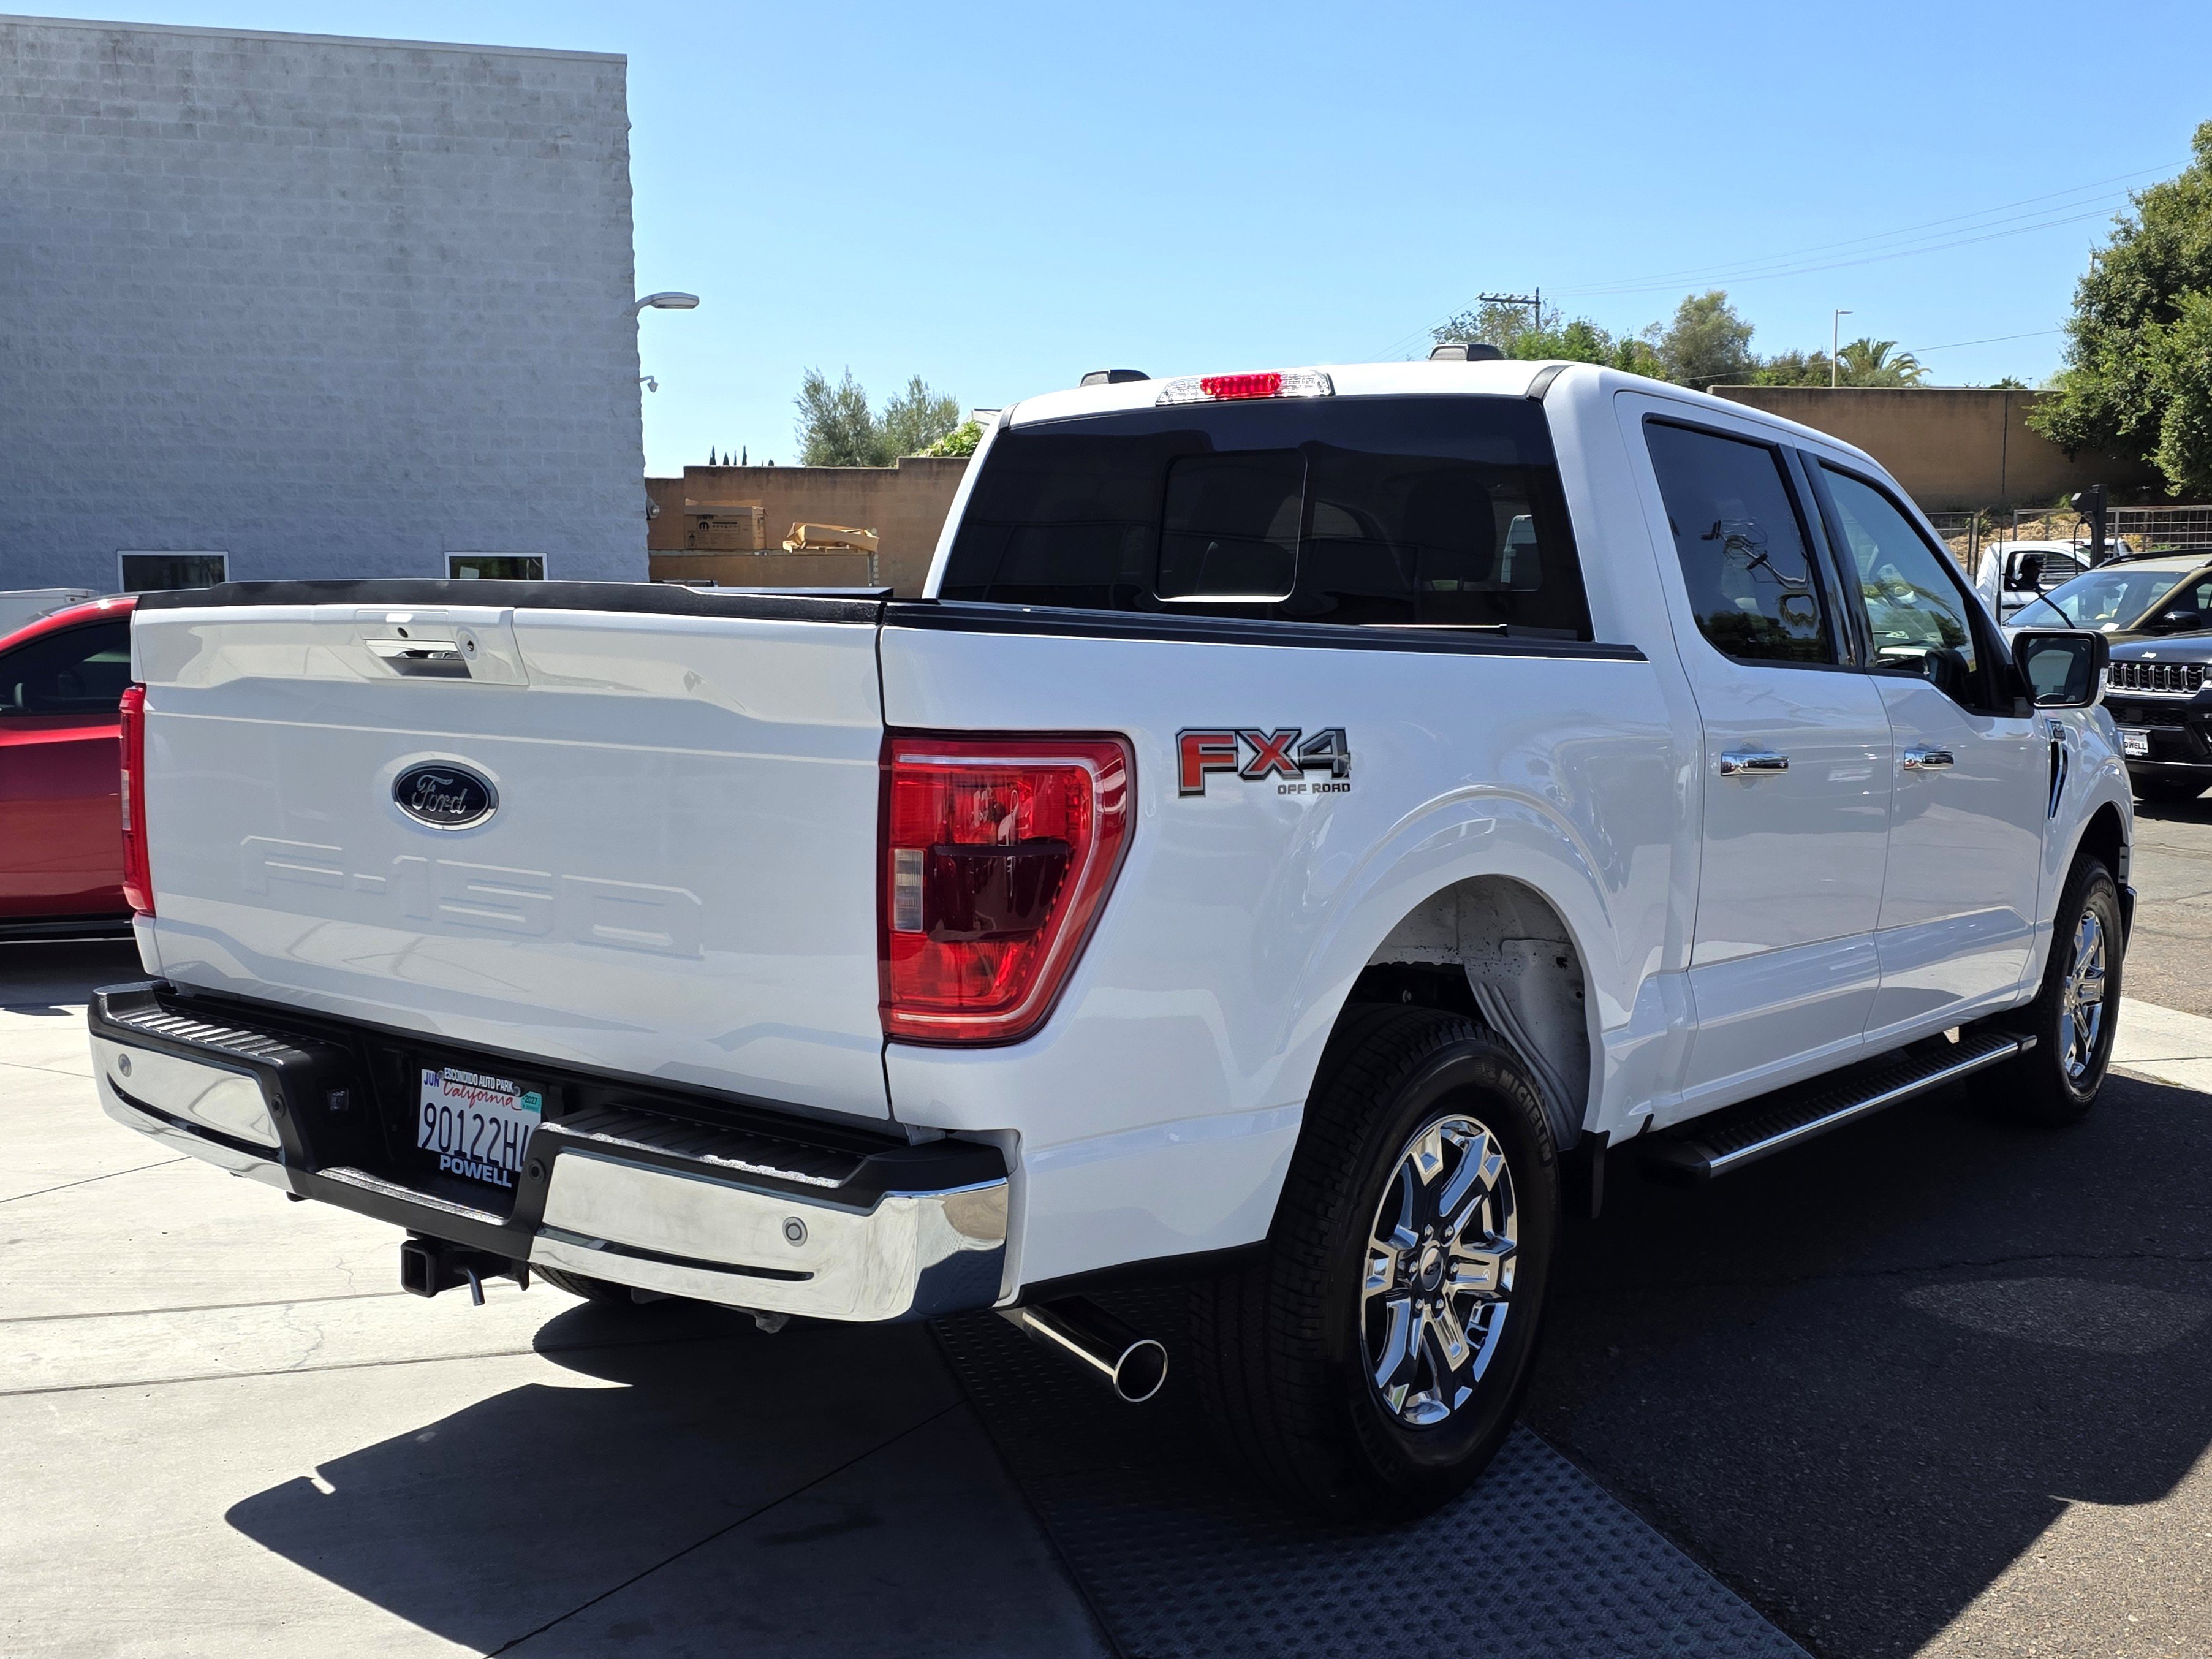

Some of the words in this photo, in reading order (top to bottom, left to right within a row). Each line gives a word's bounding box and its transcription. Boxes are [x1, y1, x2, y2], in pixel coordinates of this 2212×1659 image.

[1175, 727, 1352, 798] FX4
[412, 775, 468, 814] Ford
[1278, 784, 1307, 795] OFF
[1312, 783, 1351, 792] ROAD
[241, 835, 705, 961] F-150
[424, 1072, 440, 1088] JUN
[443, 1080, 522, 1111] California
[444, 1067, 478, 1086] ESCONDIDO
[479, 1074, 495, 1090] AUTO
[496, 1078, 513, 1093] PARK
[1499, 1069, 1553, 1162] MICHELIN
[439, 1154, 512, 1188] POWELL
